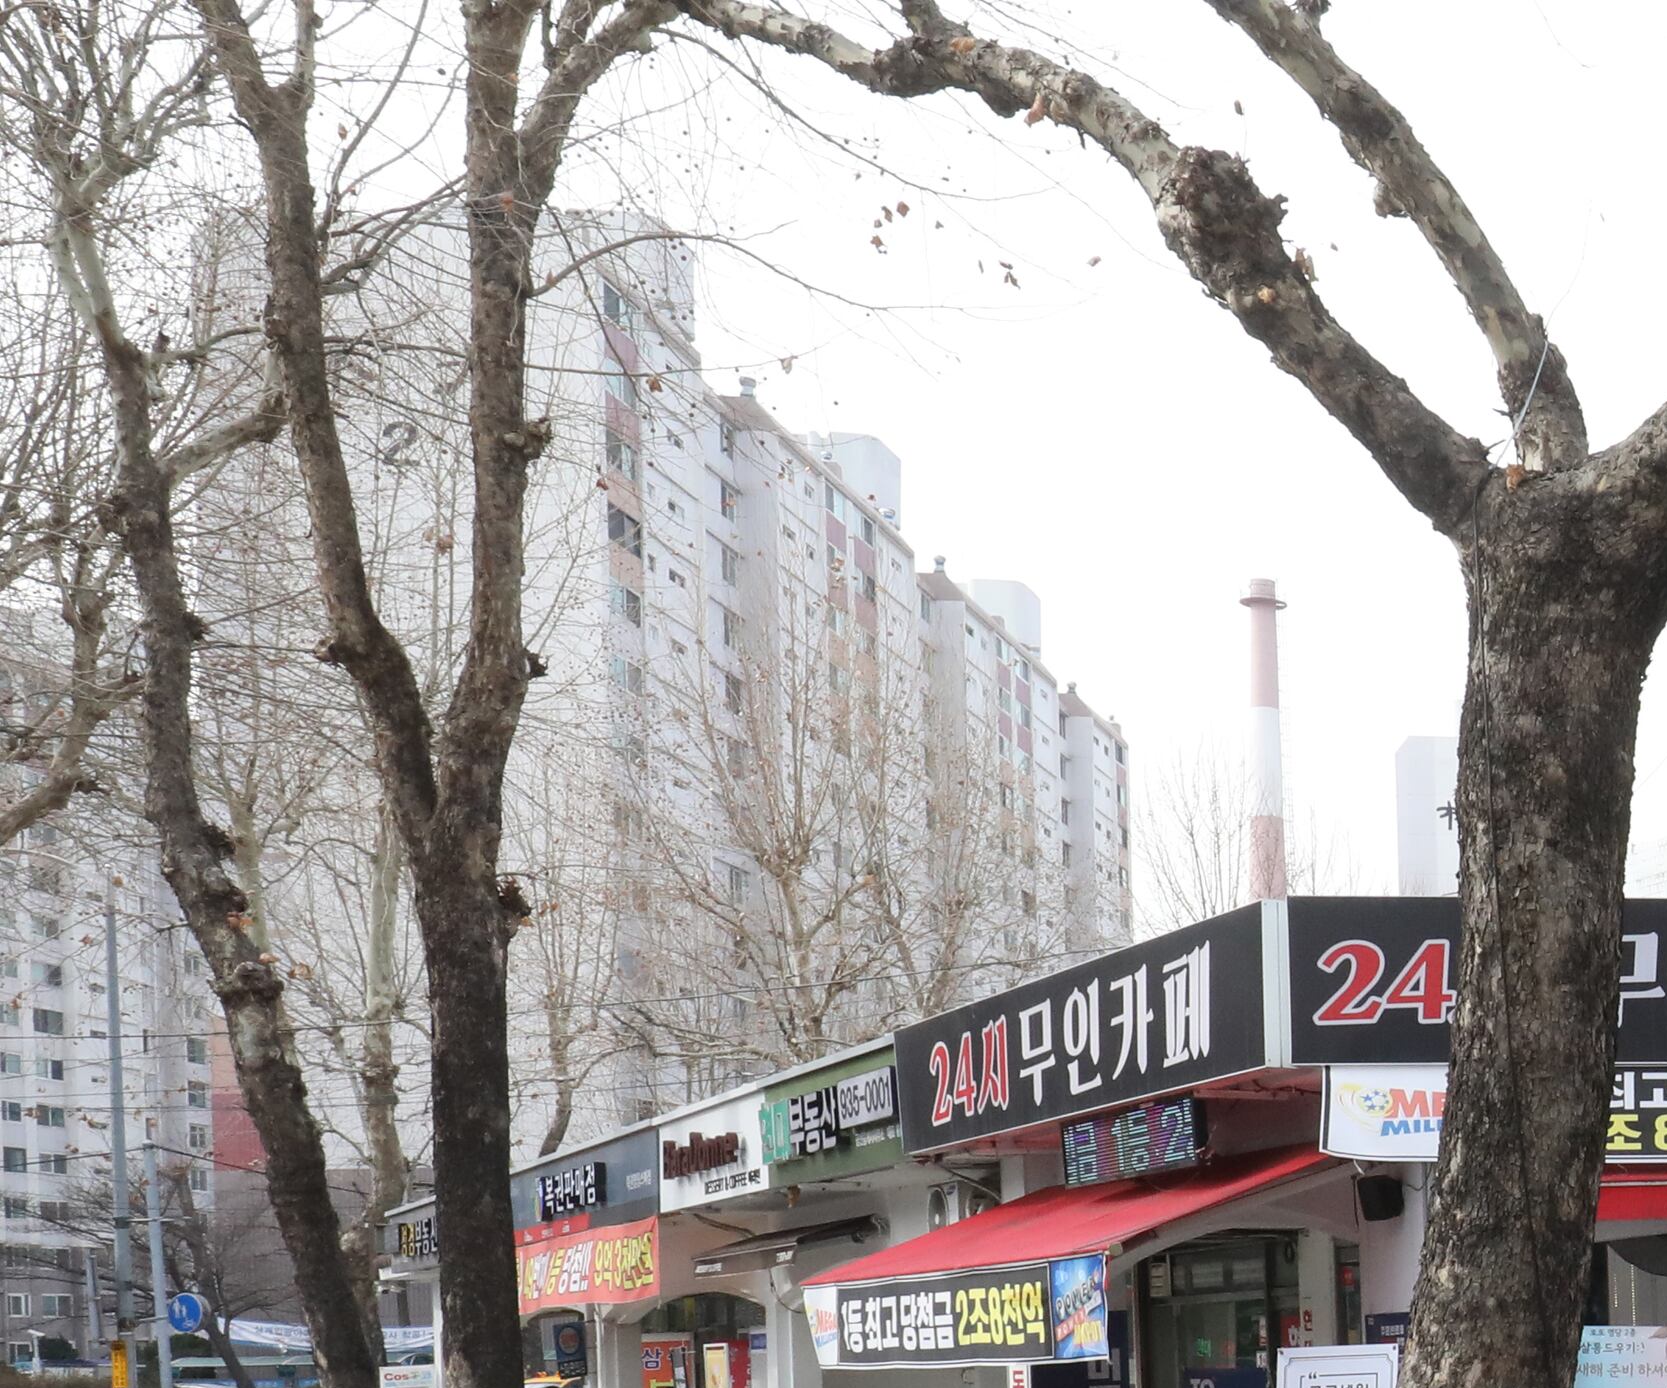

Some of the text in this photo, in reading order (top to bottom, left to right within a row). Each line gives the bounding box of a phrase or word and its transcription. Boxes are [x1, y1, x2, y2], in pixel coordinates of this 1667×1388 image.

[1314, 938, 1457, 1026] 24
[929, 940, 1211, 1127] 24시 무인카페
[838, 1076, 891, 1126] 935-0001
[1390, 1088, 1446, 1119] ME
[546, 1162, 596, 1214] 복권판매점
[842, 1281, 1045, 1353] 1등 최고 당첨금 2조8천억
[1578, 1363, 1603, 1377] 새해
[1607, 1363, 1633, 1378] 준비
